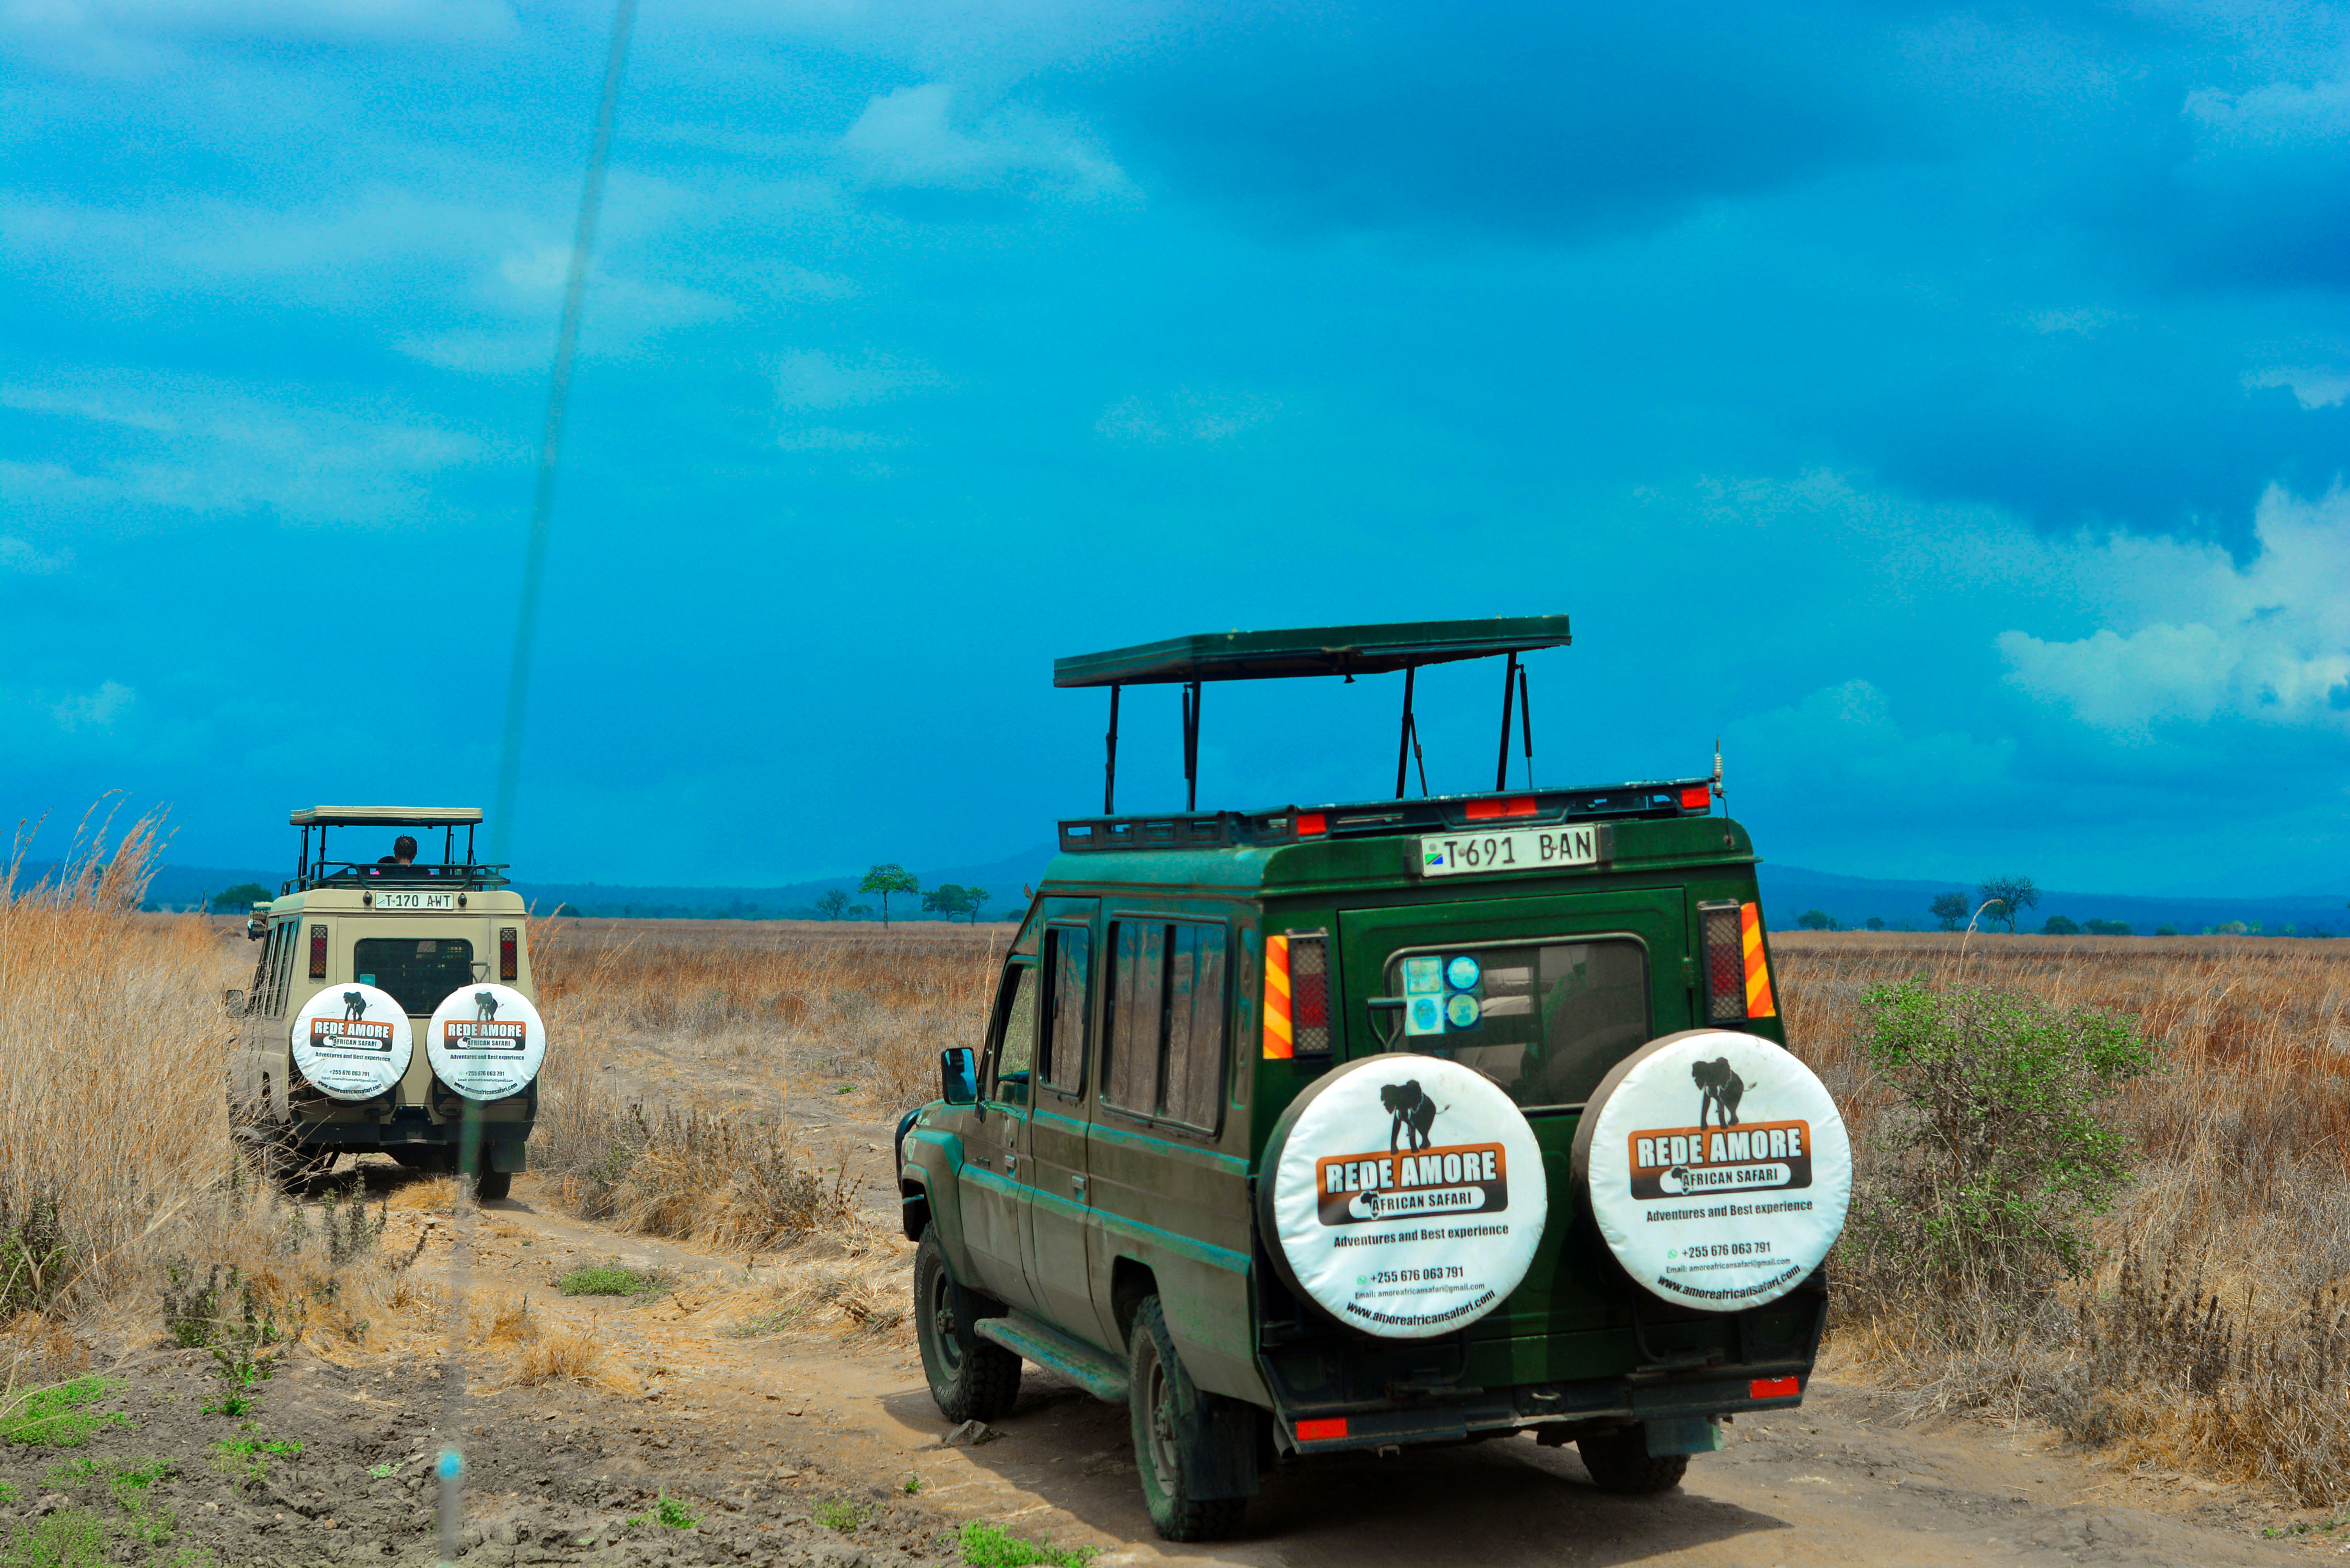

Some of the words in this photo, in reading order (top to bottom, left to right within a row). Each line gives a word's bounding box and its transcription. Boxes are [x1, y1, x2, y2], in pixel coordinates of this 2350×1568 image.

[1540, 831, 1592, 861] BAN
[427, 895, 450, 907] AWT
[314, 1021, 344, 1035] REDE
[347, 1023, 389, 1039] AMORE
[448, 1023, 477, 1036] REDE
[480, 1024, 522, 1037] AMORE
[1637, 1135, 1703, 1167] REDE
[1710, 1128, 1801, 1162] AMORE
[1326, 1159, 1393, 1193] REDE
[1401, 1151, 1496, 1187] AMORE
[1682, 1171, 1732, 1187] AFRICAN
[1737, 1168, 1778, 1182] SAFARI
[1372, 1195, 1424, 1213] AFRICAN
[1429, 1192, 1471, 1207] SAFARI
[1646, 1205, 1705, 1221] Adventures
[1708, 1206, 1726, 1217] and
[1730, 1204, 1753, 1216] Best
[1756, 1201, 1812, 1214] experience
[1334, 1229, 1396, 1248] Adventures
[1399, 1230, 1418, 1242] and
[1421, 1229, 1445, 1240] Best
[1448, 1225, 1508, 1239] experience
[1682, 1246, 1708, 1258] +255
[1711, 1245, 1729, 1256] 676
[1732, 1243, 1752, 1254] 063
[1754, 1241, 1770, 1253] 791
[1370, 1271, 1398, 1283] +255
[1401, 1270, 1420, 1281] 676
[1423, 1267, 1443, 1279] 063
[1446, 1266, 1464, 1277] 791
[1657, 1265, 1801, 1300] www.amoreafricansafari.com
[1346, 1290, 1495, 1325] www.amoreafricansafari.com
